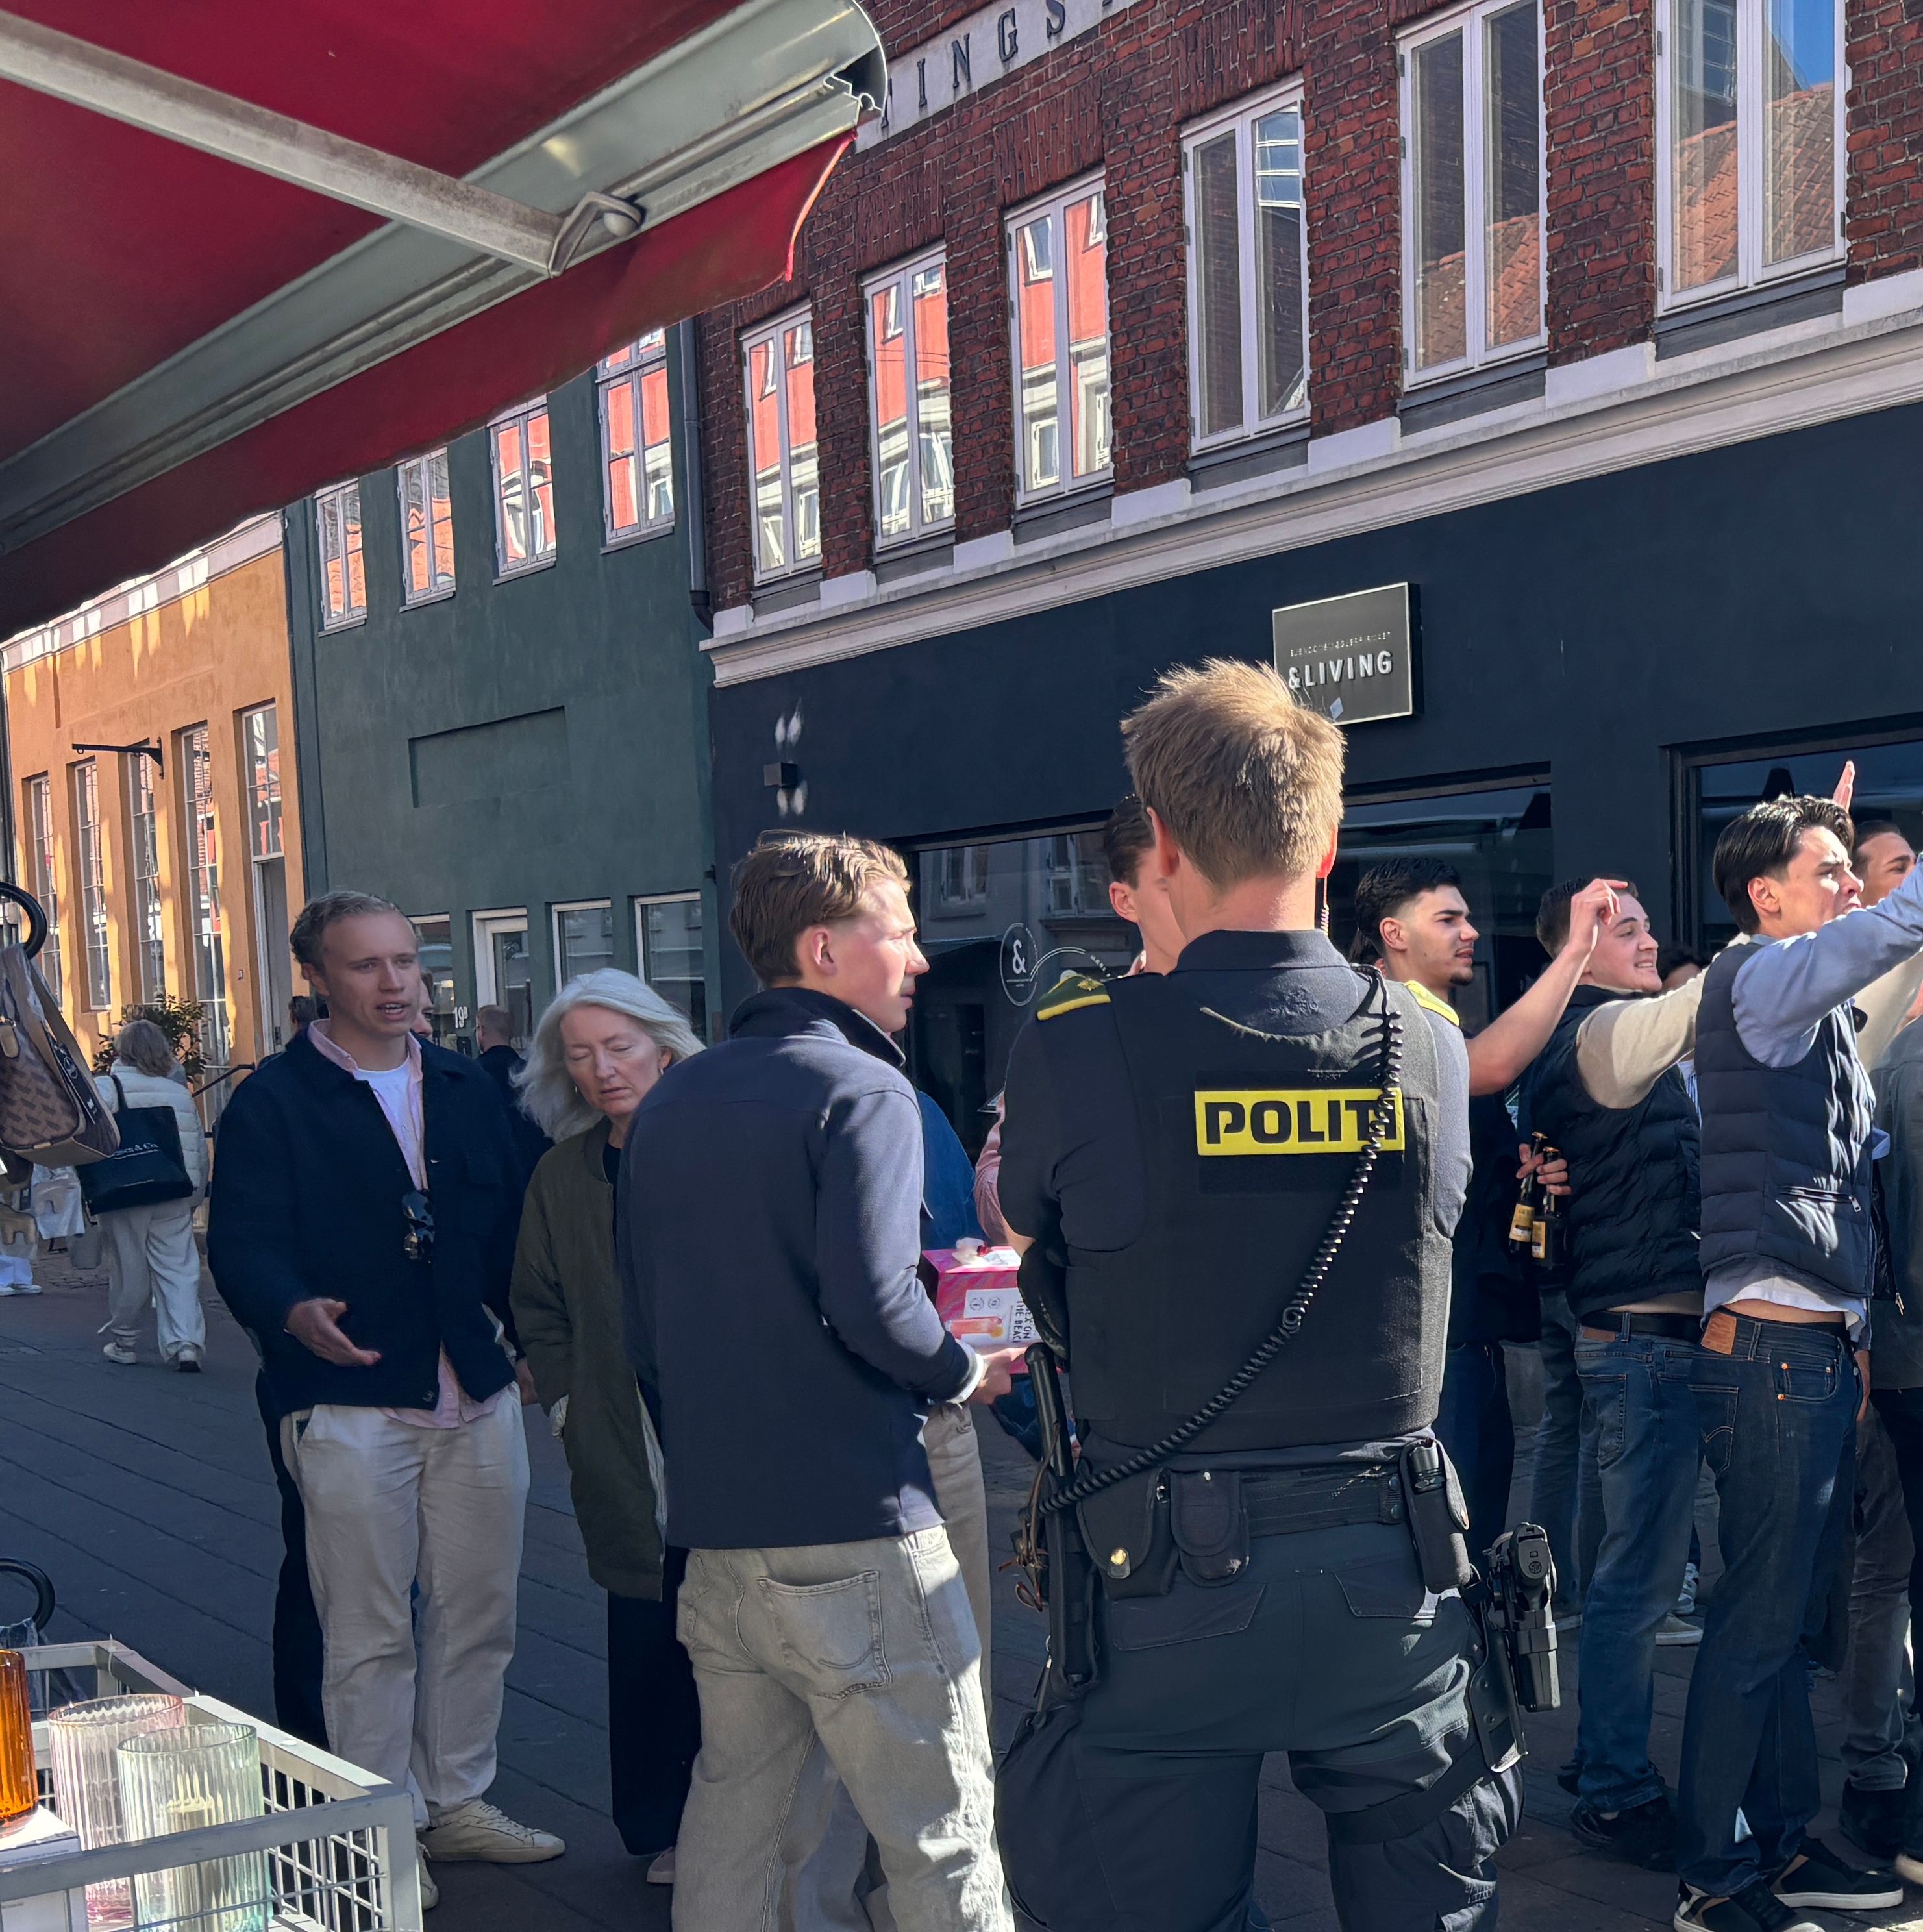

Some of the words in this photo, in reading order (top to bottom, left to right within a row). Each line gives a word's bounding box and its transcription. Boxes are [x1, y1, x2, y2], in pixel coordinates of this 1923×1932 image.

[881, 0, 1113, 129] INGS
[1289, 650, 1393, 689] &LIVING
[453, 1006, 468, 1028] 19B
[1205, 1100, 1397, 1145] POLITI
[1023, 1326, 1032, 1339] ON
